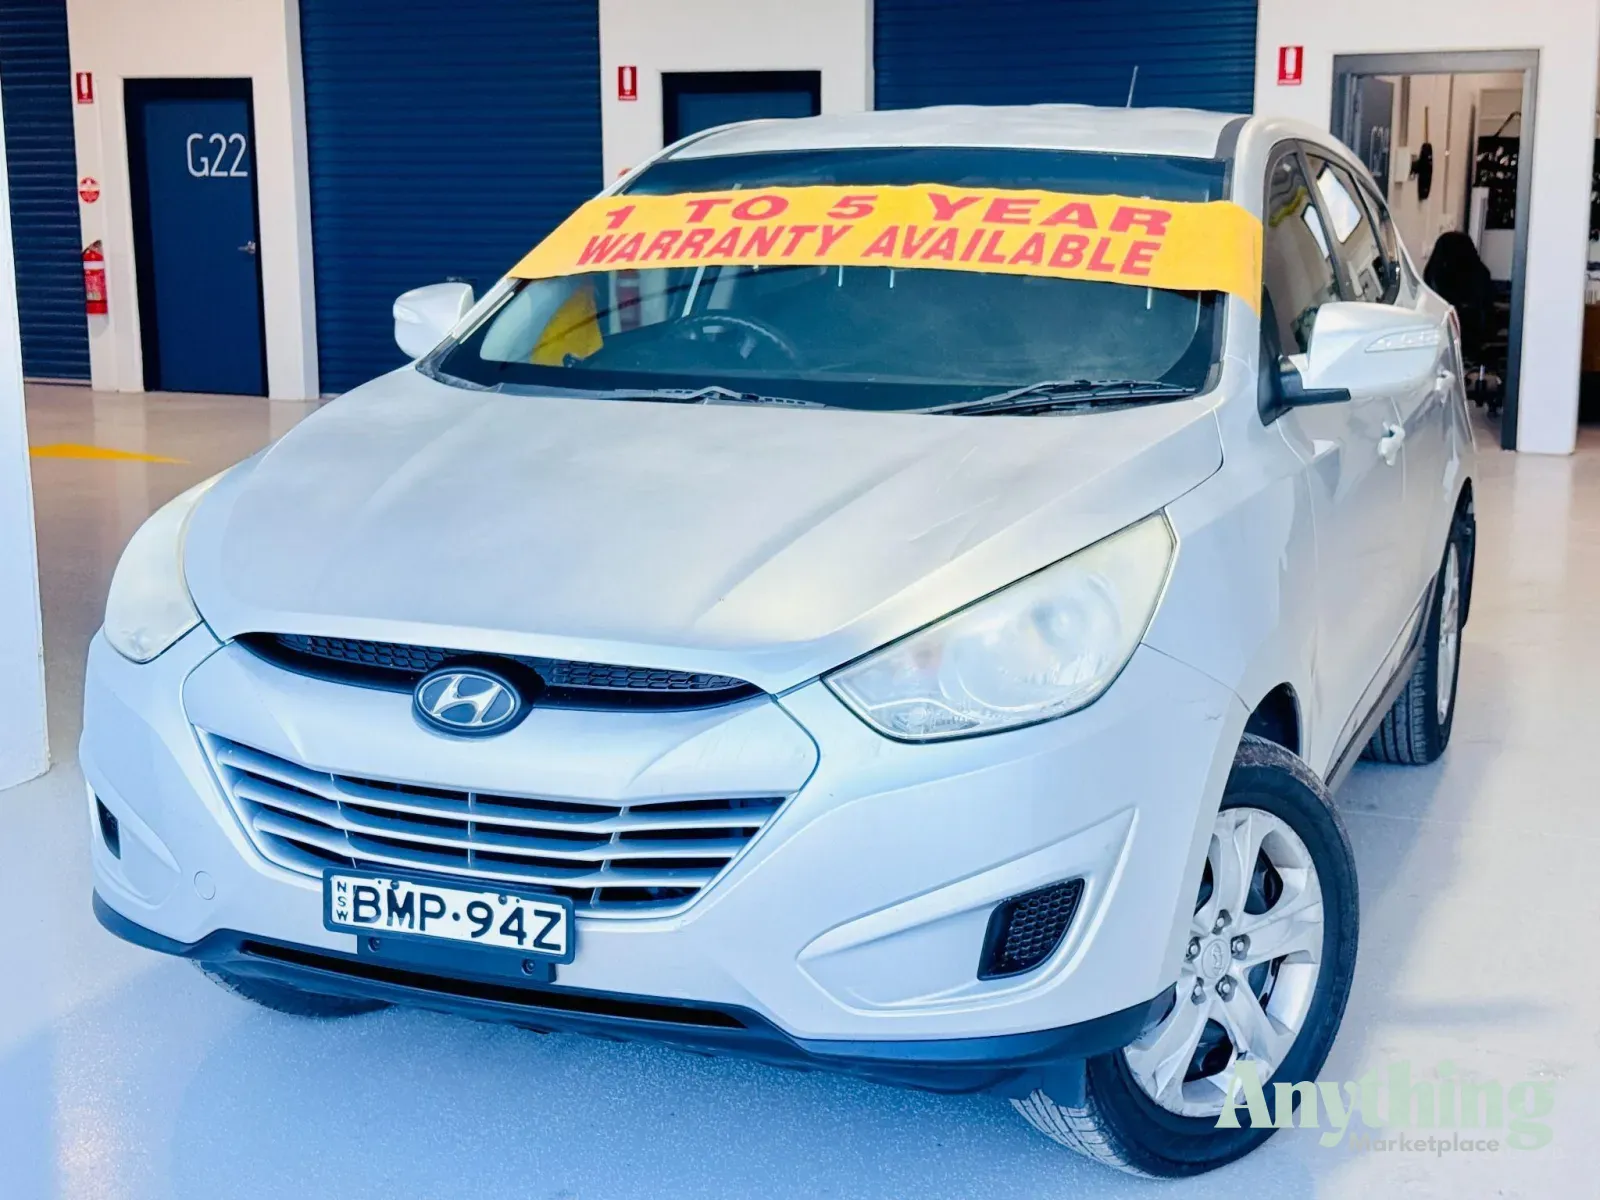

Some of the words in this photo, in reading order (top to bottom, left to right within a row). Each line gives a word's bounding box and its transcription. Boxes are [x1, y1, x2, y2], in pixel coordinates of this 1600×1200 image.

[187, 133, 248, 177] G22
[605, 204, 637, 230] 1
[685, 195, 790, 224] TO
[827, 195, 879, 220] 5
[928, 192, 1173, 237] YEAR
[575, 225, 855, 267] WARRANTY
[860, 225, 1162, 276] AVAILABLE
[336, 880, 349, 922] NSW
